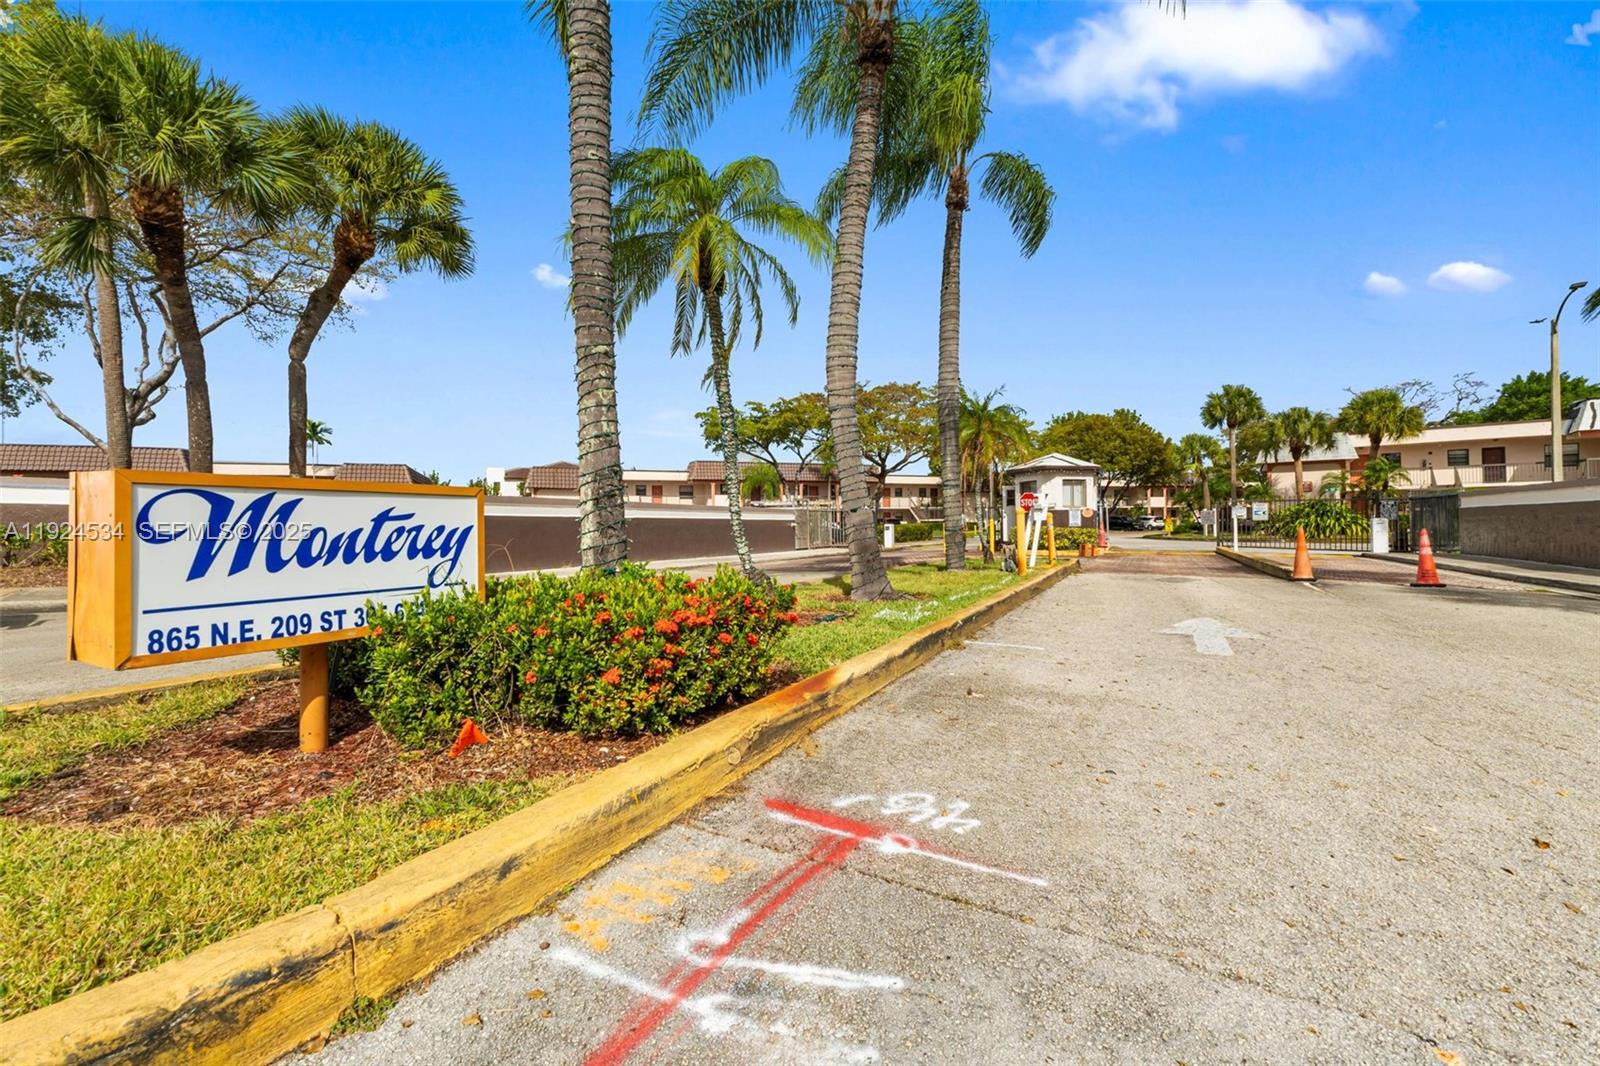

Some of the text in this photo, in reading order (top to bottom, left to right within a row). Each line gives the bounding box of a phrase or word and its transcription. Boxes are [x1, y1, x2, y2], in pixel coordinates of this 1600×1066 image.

[136, 488, 475, 589] Monterey
[147, 625, 200, 655] 865
[211, 619, 262, 647] N.E.
[271, 613, 312, 639] 209
[320, 609, 347, 632] ST
